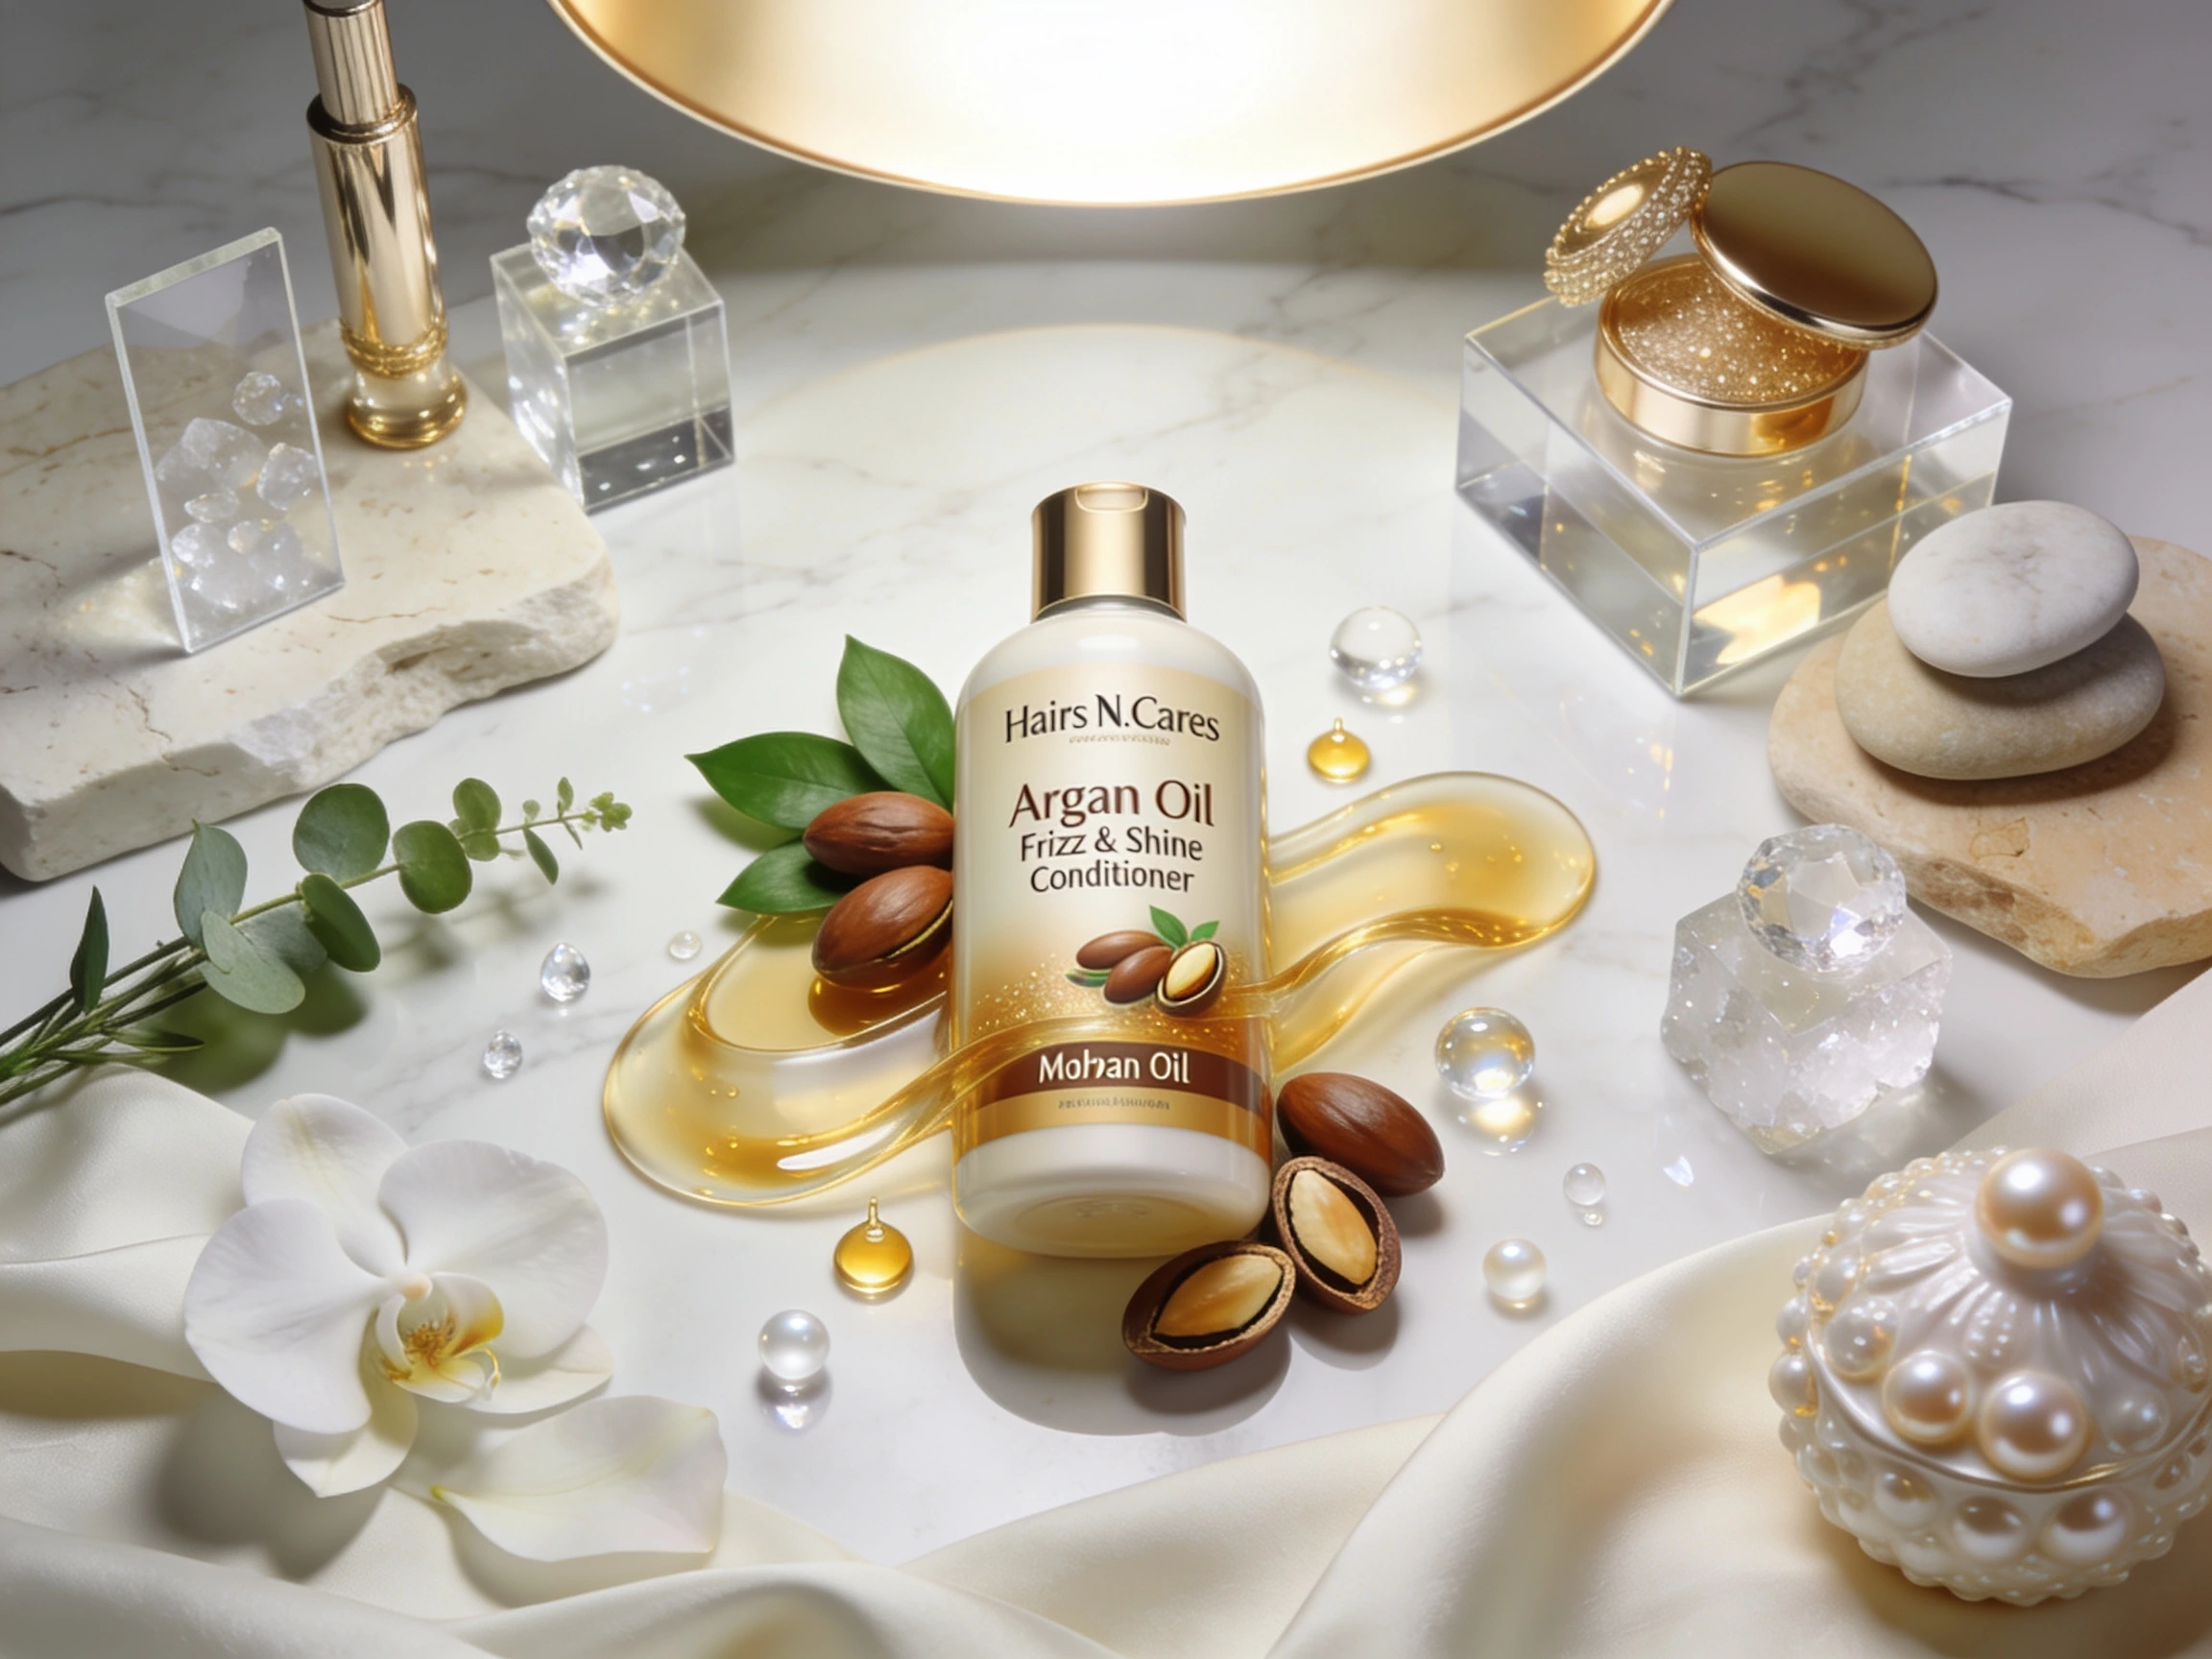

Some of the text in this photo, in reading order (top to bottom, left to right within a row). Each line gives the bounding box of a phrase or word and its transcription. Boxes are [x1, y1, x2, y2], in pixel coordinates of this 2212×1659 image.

[1005, 700, 1087, 743] Hairs
[1009, 780, 1214, 828] Argan Oil
[1021, 826, 1203, 862] Frizz & Shine
[1030, 859, 1194, 893] Conditioner
[1149, 1051, 1190, 1084] Oil
